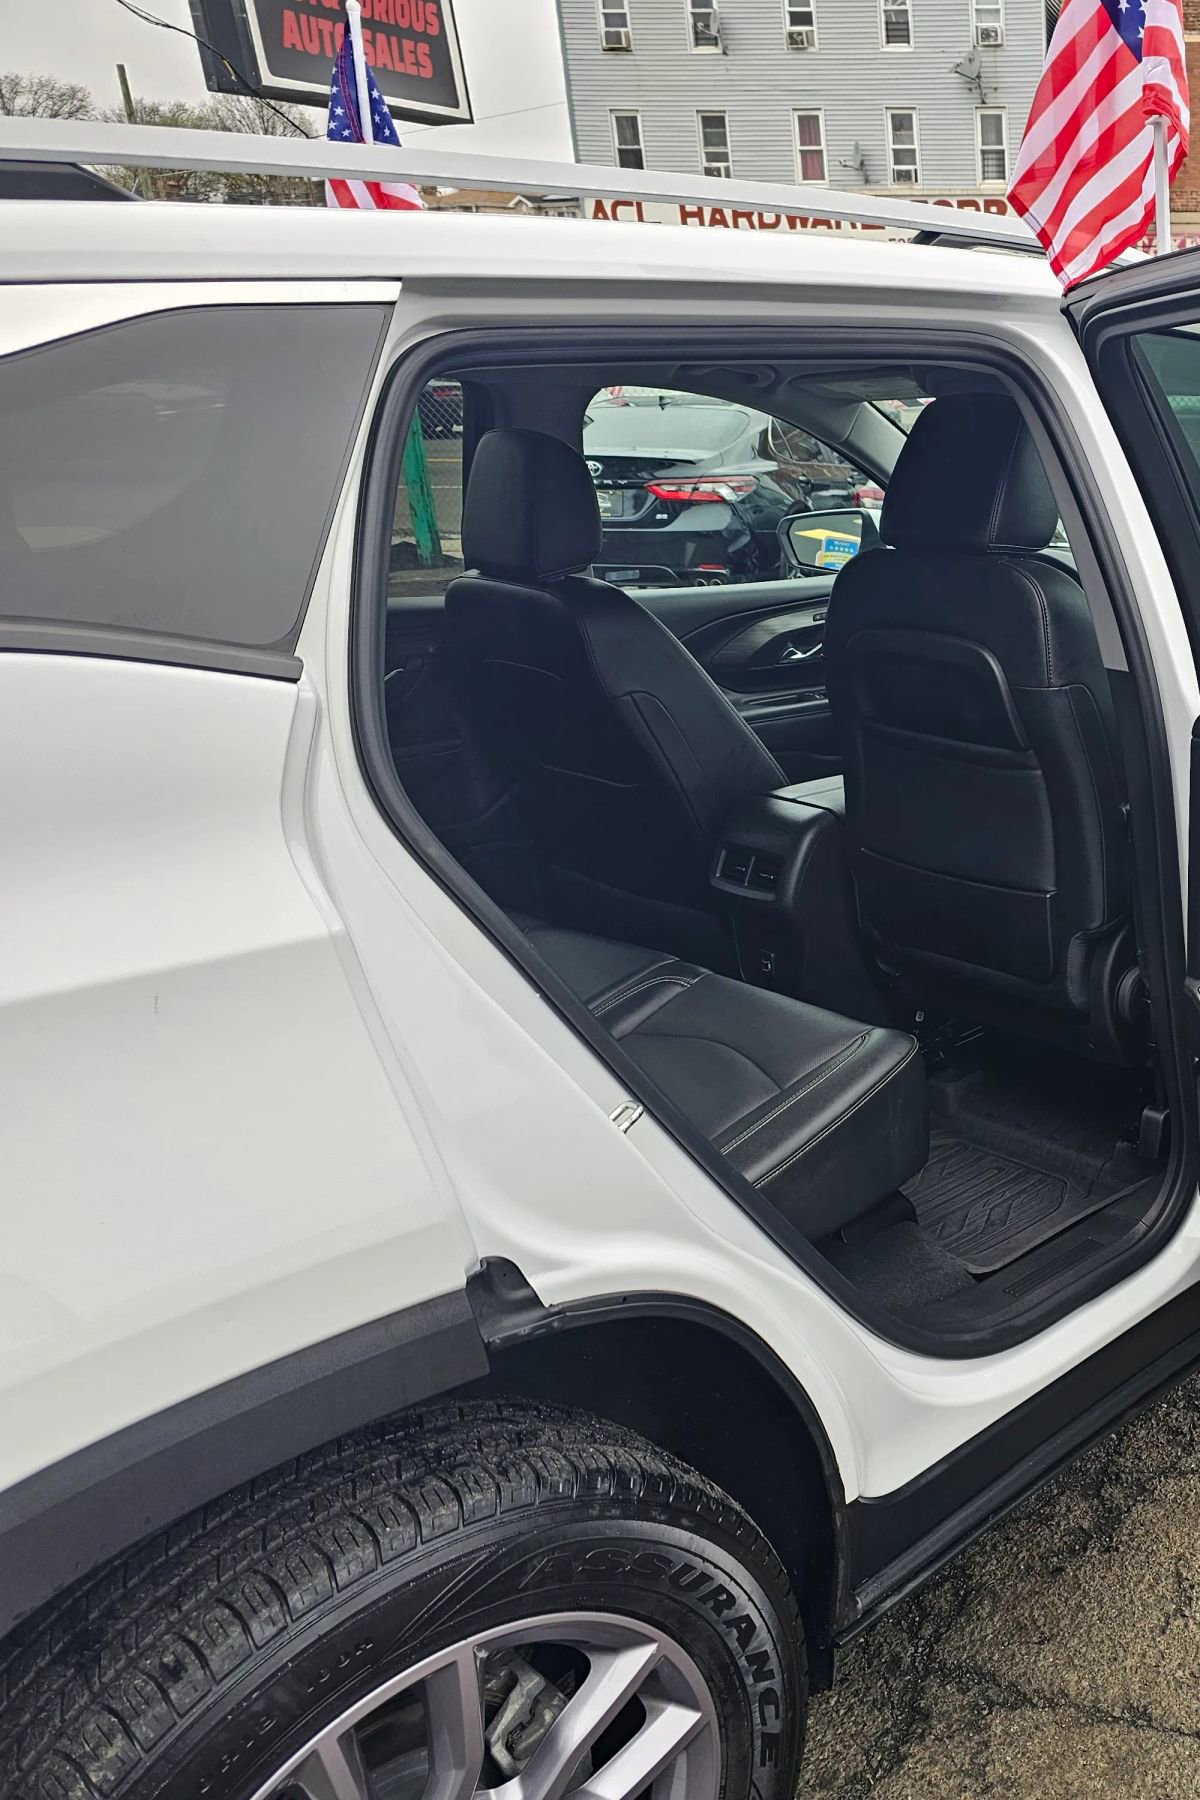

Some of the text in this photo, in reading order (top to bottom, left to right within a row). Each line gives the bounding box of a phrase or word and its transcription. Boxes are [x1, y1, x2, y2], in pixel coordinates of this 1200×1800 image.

[362, 29, 433, 78] SALES
[679, 204, 886, 230] HARD
[518, 1547, 780, 1769] ASSURANCE
